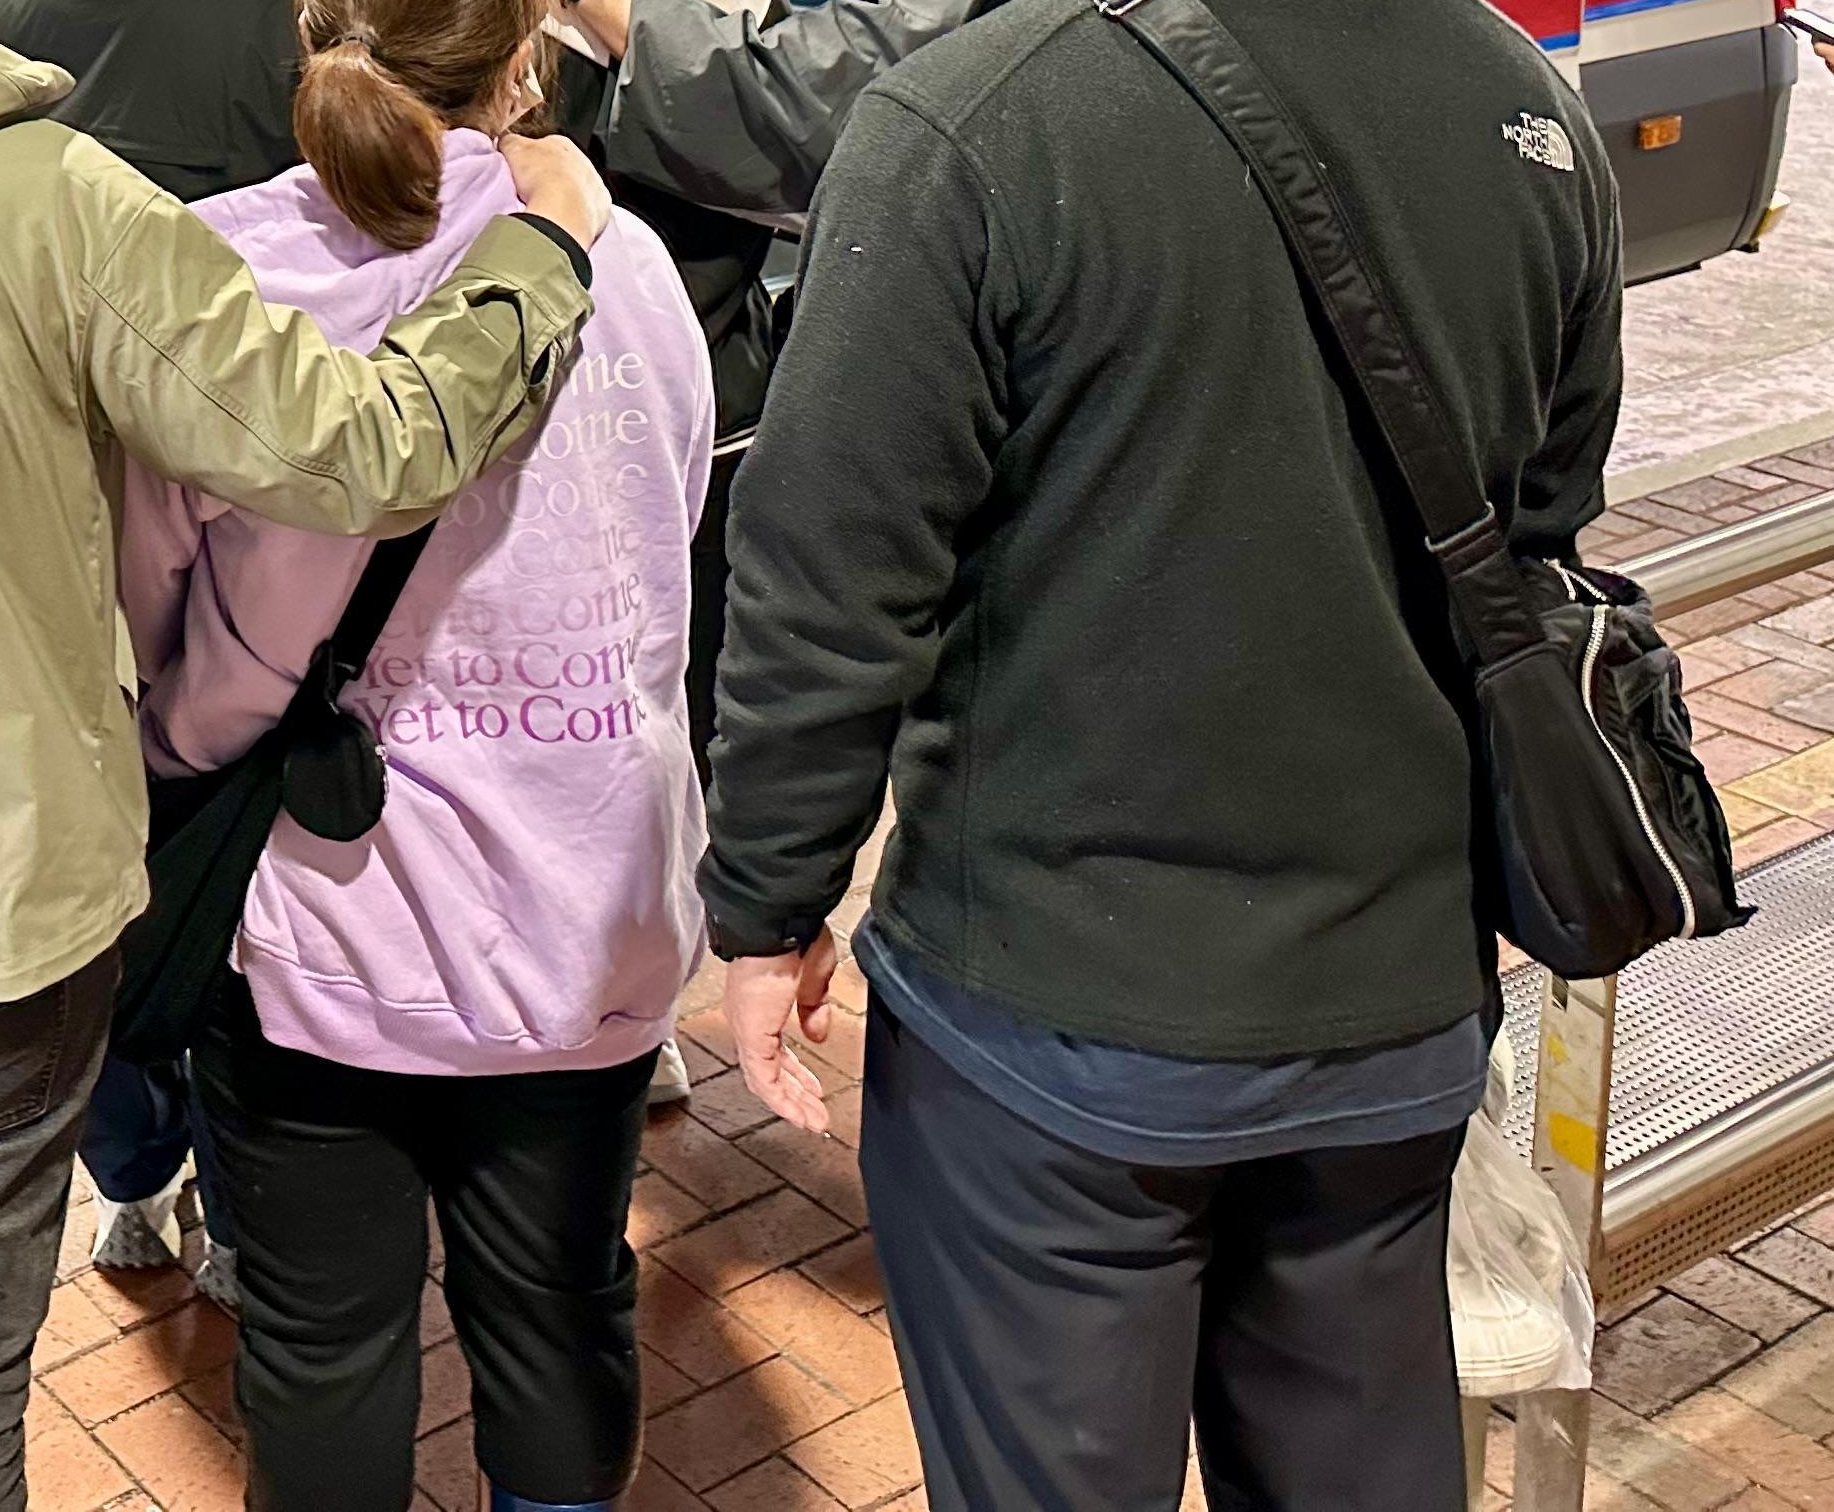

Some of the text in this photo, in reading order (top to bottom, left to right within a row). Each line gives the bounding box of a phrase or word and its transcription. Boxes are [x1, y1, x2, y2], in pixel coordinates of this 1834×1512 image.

[1502, 124, 1548, 149] NORTH
[1520, 112, 1548, 135] THE
[1519, 143, 1552, 165] FACE
[511, 573, 643, 635] Come
[448, 649, 503, 687] to
[354, 694, 444, 748] Yet
[453, 700, 509, 739] to
